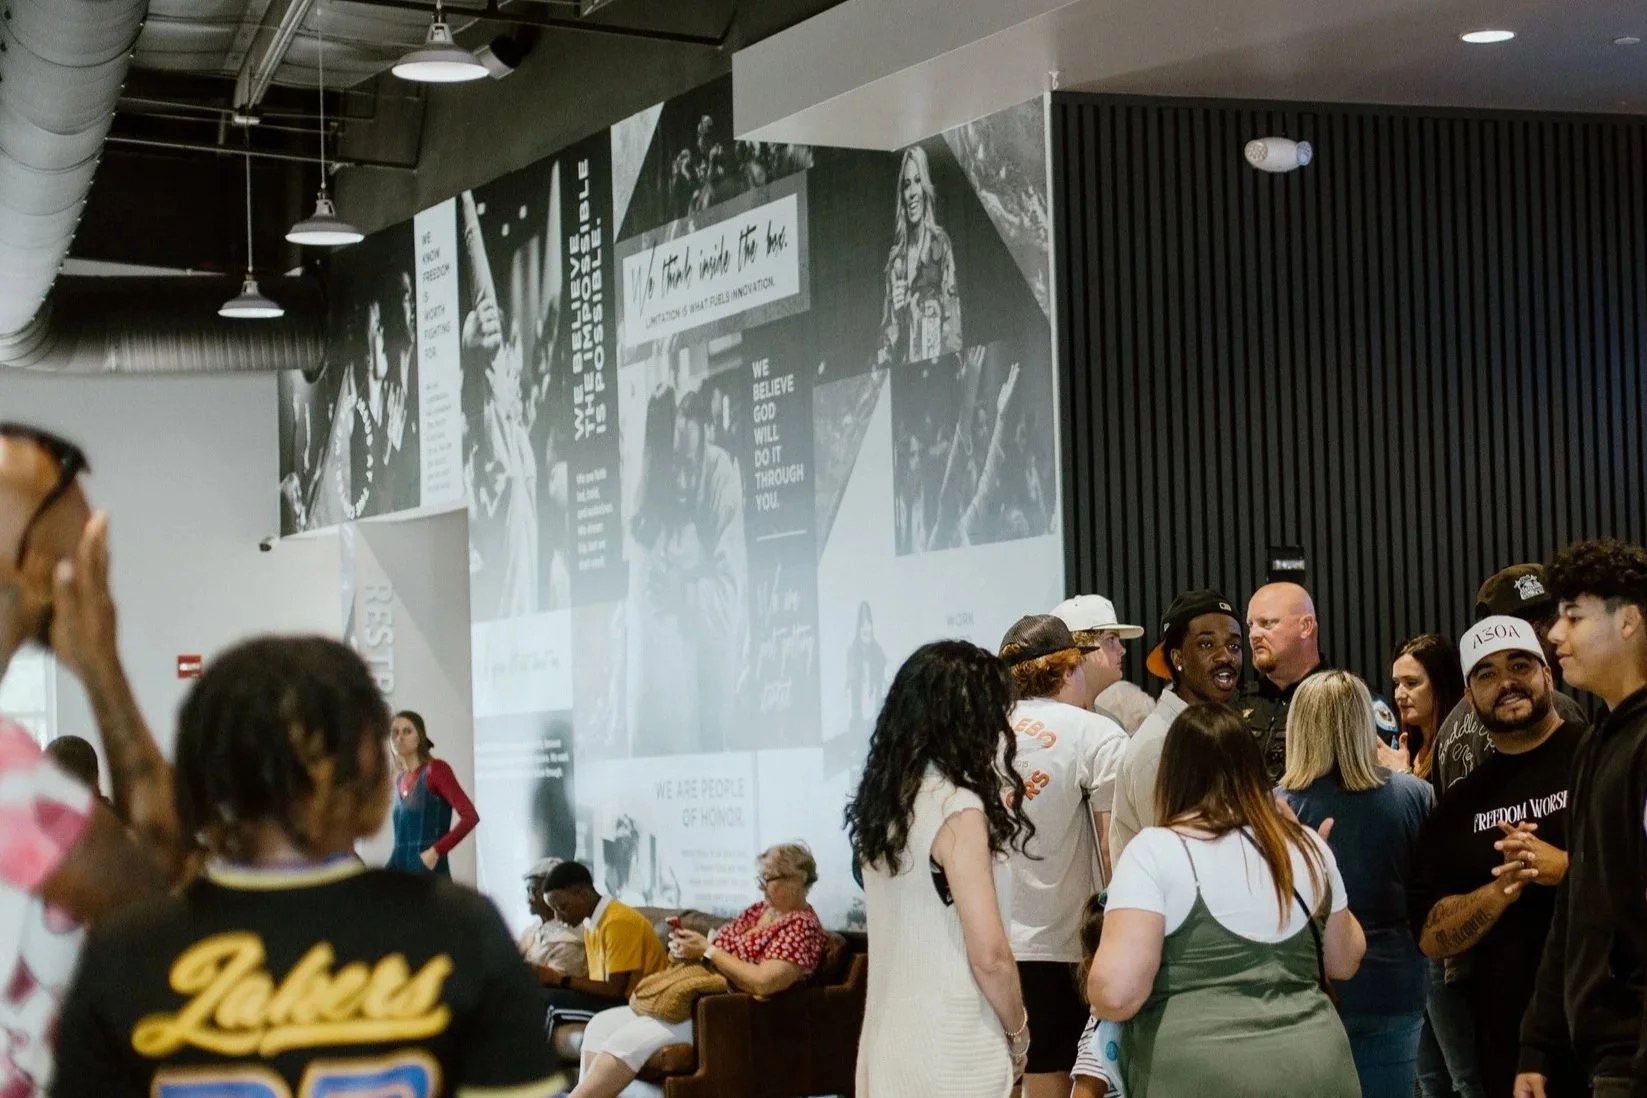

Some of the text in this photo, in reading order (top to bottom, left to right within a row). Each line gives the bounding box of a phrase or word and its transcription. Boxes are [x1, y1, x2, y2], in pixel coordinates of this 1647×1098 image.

[423, 263, 450, 281] FREEDOM
[631, 219, 788, 318] We think inside the box.
[578, 158, 596, 438] THE IMPOSSIBLE
[645, 308, 681, 328] LIMITATION
[682, 305, 688, 317] IS
[689, 298, 708, 314] WHAT
[709, 291, 730, 307] FUELS
[569, 233, 584, 441] WE BELIEVE
[590, 218, 606, 435] IS POSSIBLE.
[752, 358, 770, 379] WE
[752, 374, 795, 401] BELIEVE
[753, 402, 776, 423] GOD
[754, 424, 780, 445] WILL
[754, 446, 782, 467] DO IT
[755, 463, 805, 489] THROUGH
[756, 491, 780, 512] YOU.
[656, 778, 745, 800] WE ARE PEOPLE
[682, 807, 697, 829] OF
[131, 930, 453, 1057] Lakers
